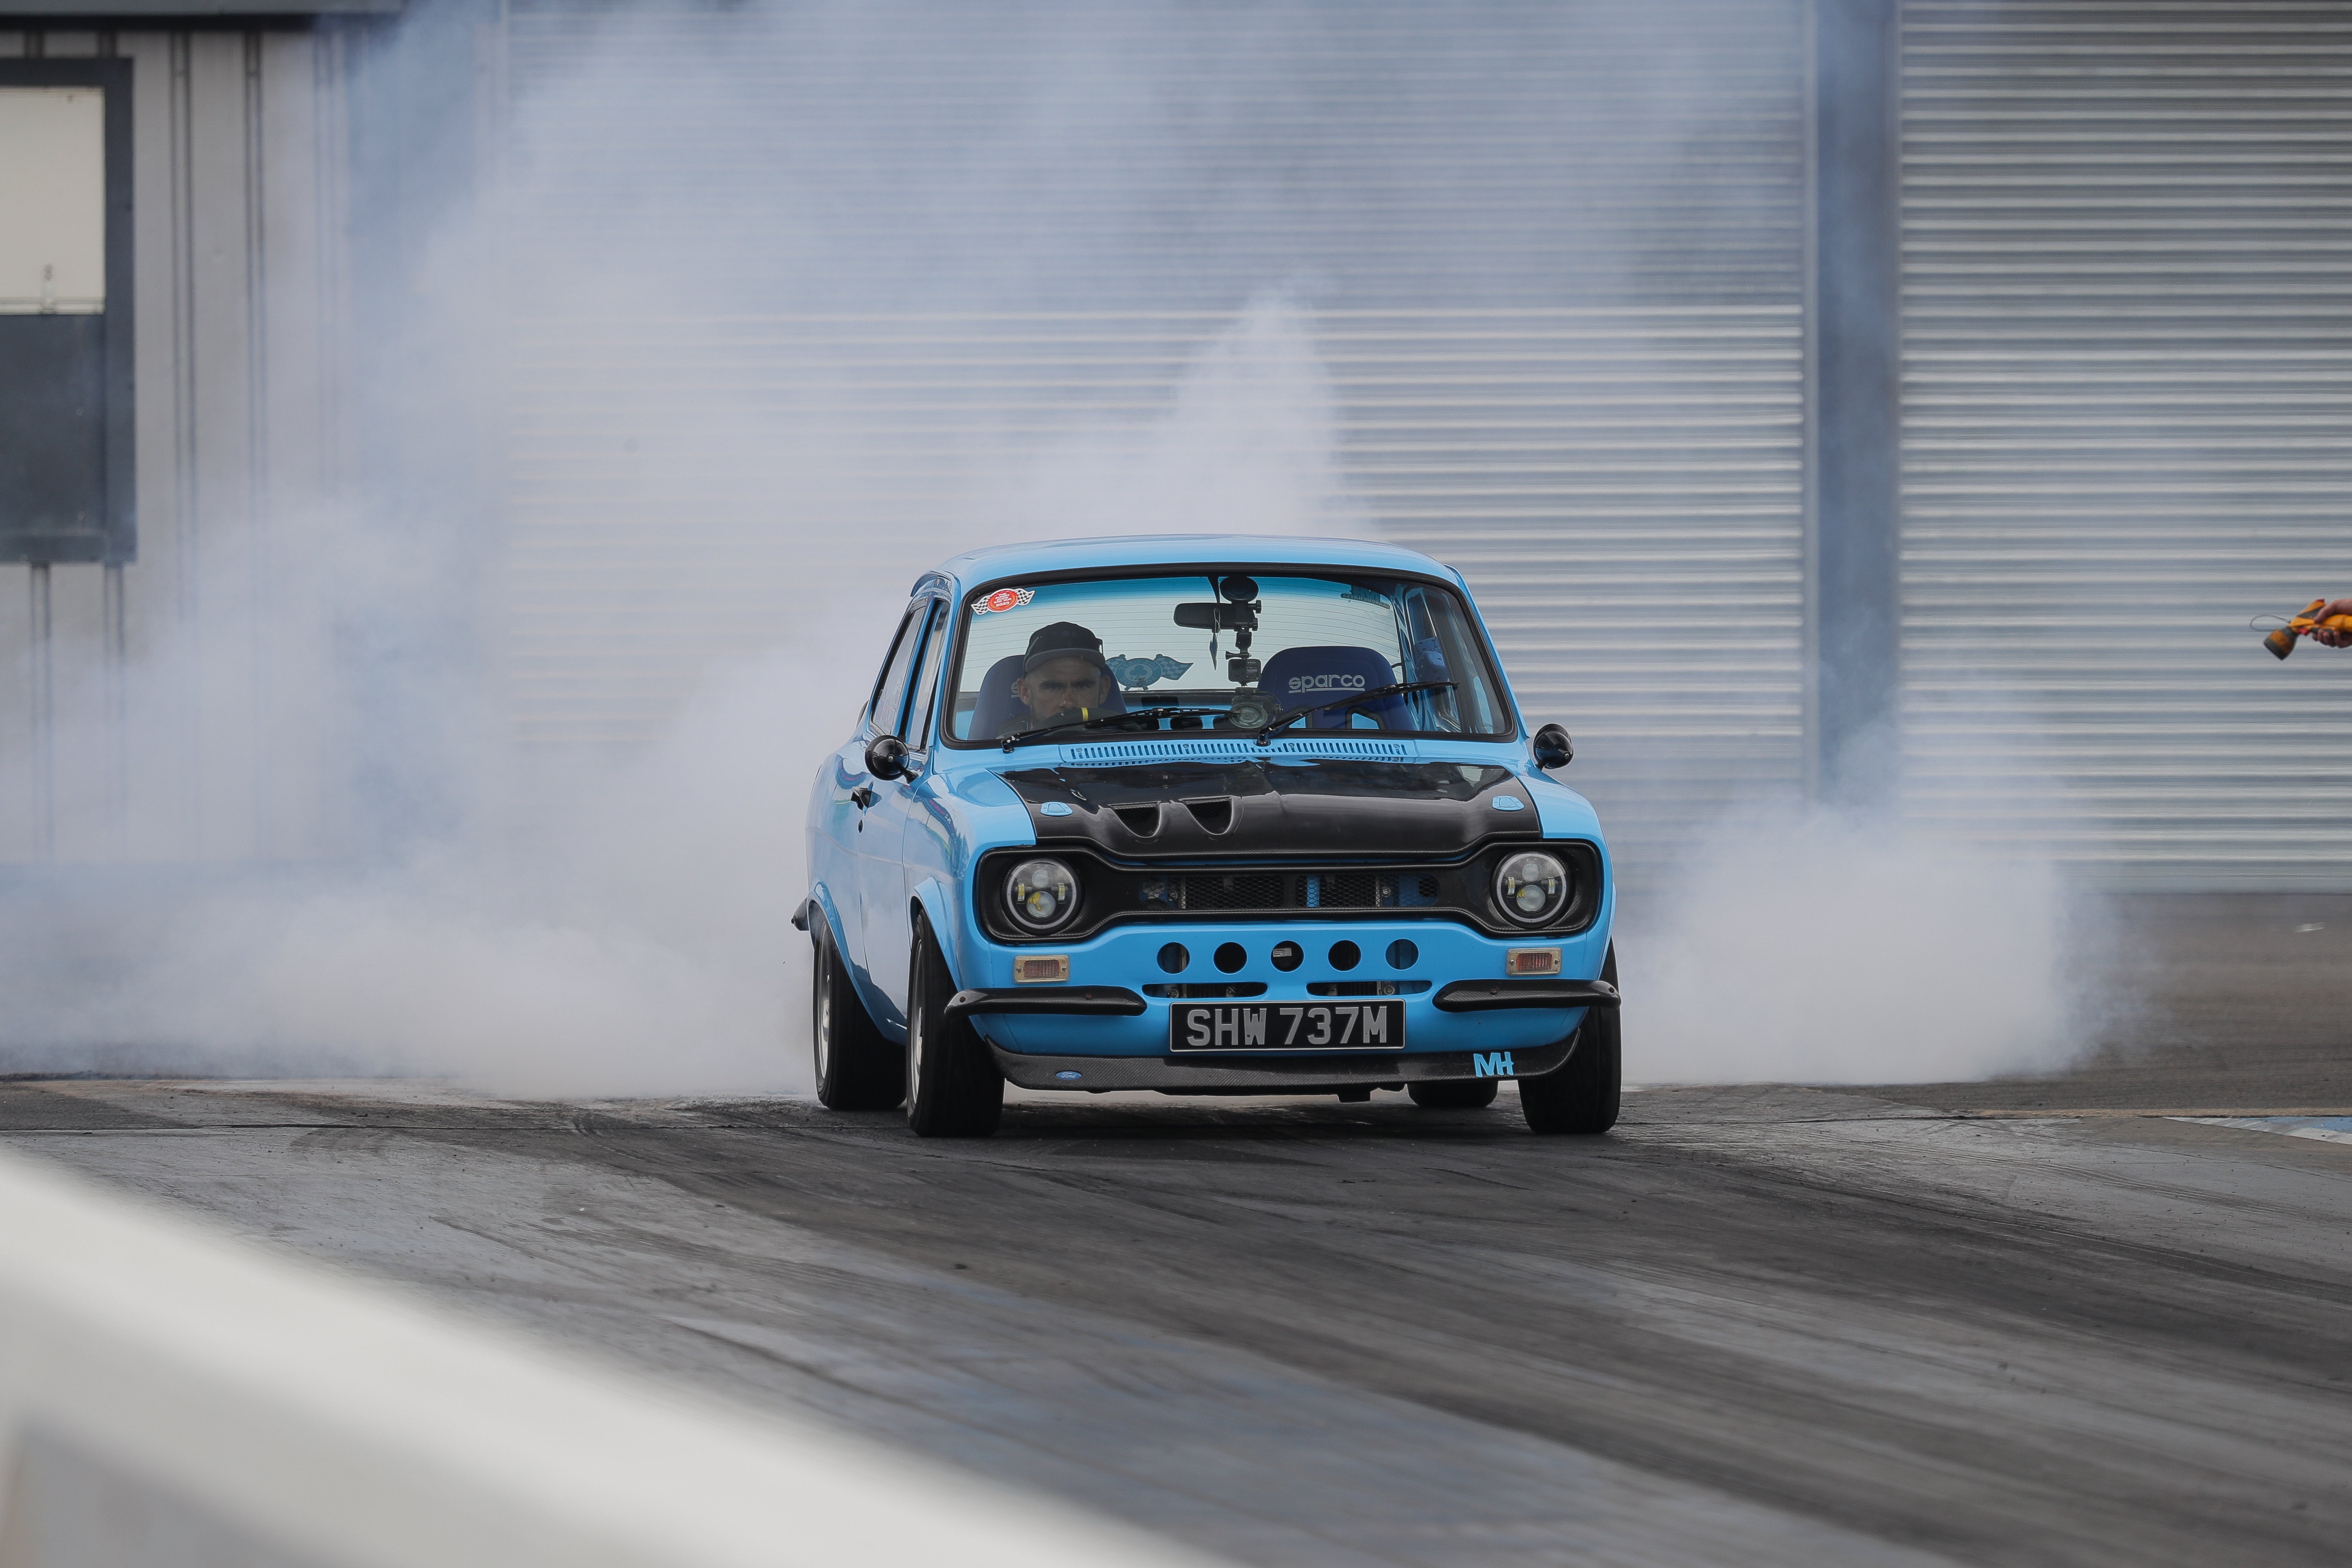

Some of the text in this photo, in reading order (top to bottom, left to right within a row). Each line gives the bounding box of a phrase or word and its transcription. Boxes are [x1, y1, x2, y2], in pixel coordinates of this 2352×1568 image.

[1289, 674, 1365, 692] sparco
[1186, 1006, 1387, 1046] SHW 737M
[1473, 1051, 1514, 1078] MH
